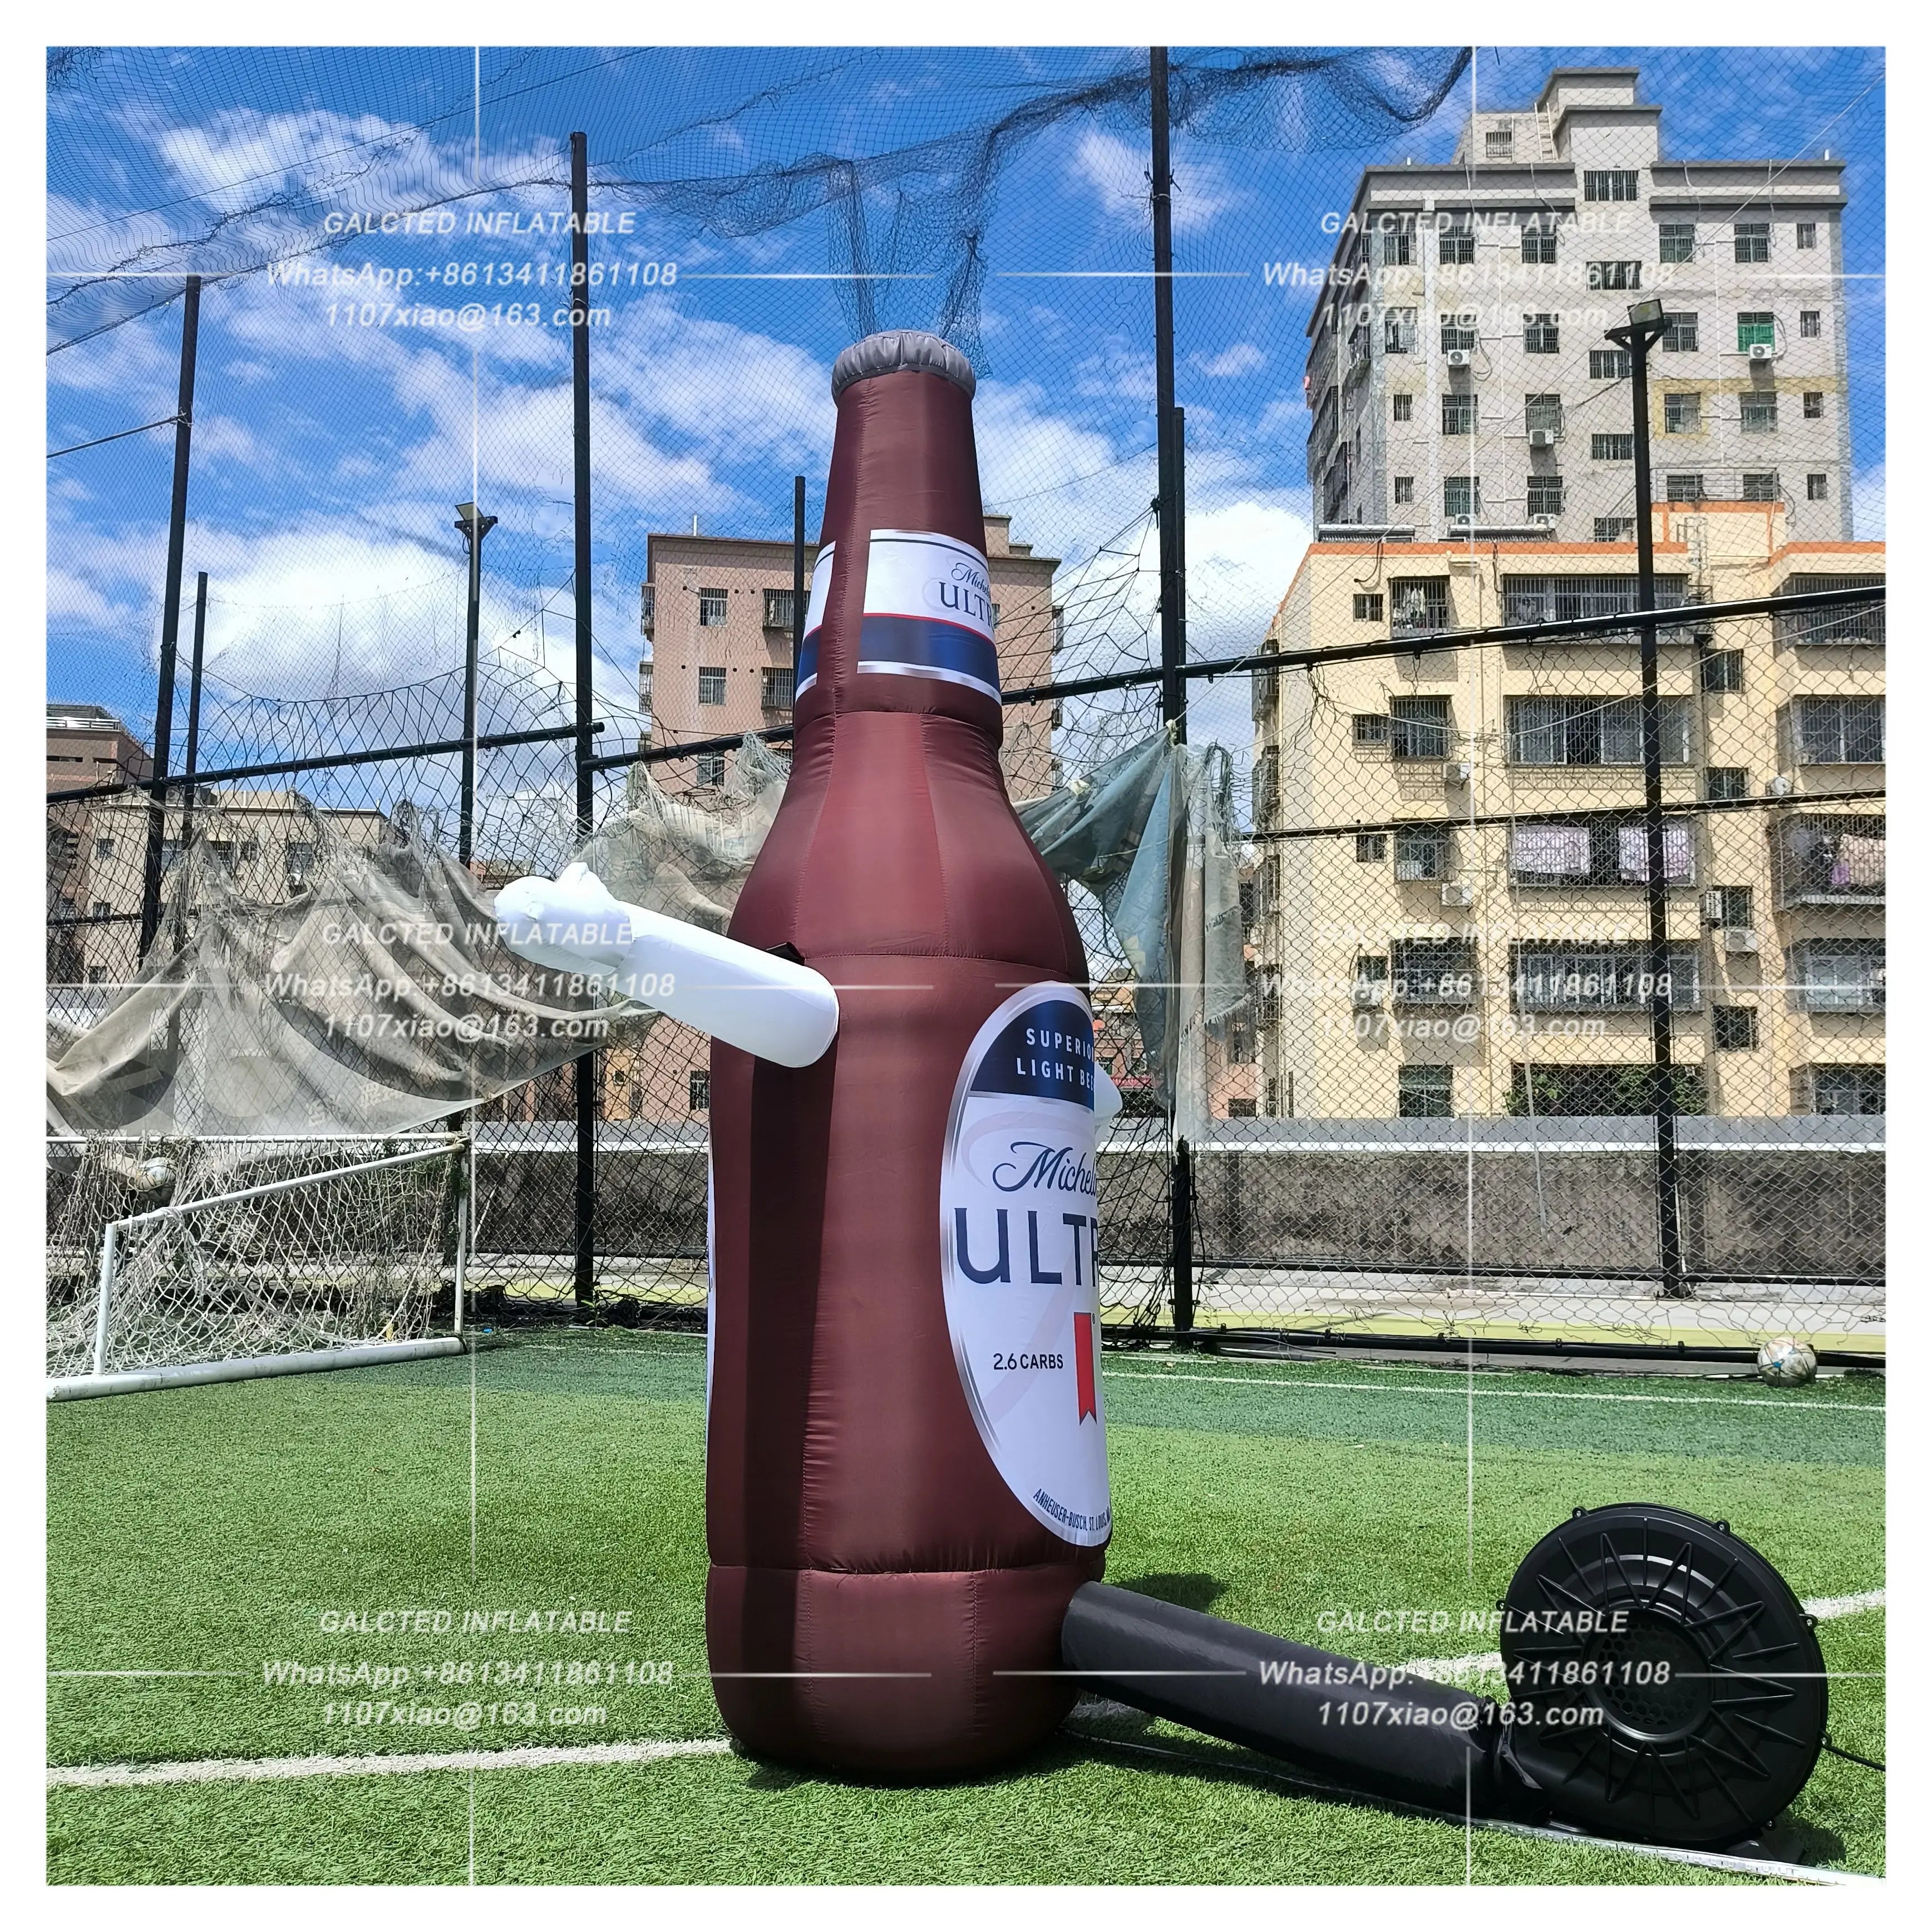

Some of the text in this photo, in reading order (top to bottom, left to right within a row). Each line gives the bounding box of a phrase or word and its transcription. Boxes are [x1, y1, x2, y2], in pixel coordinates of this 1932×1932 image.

[1017, 1058, 1094, 1091] LIGHT BEE
[993, 1353, 1064, 1370] 2.6 CARBS
